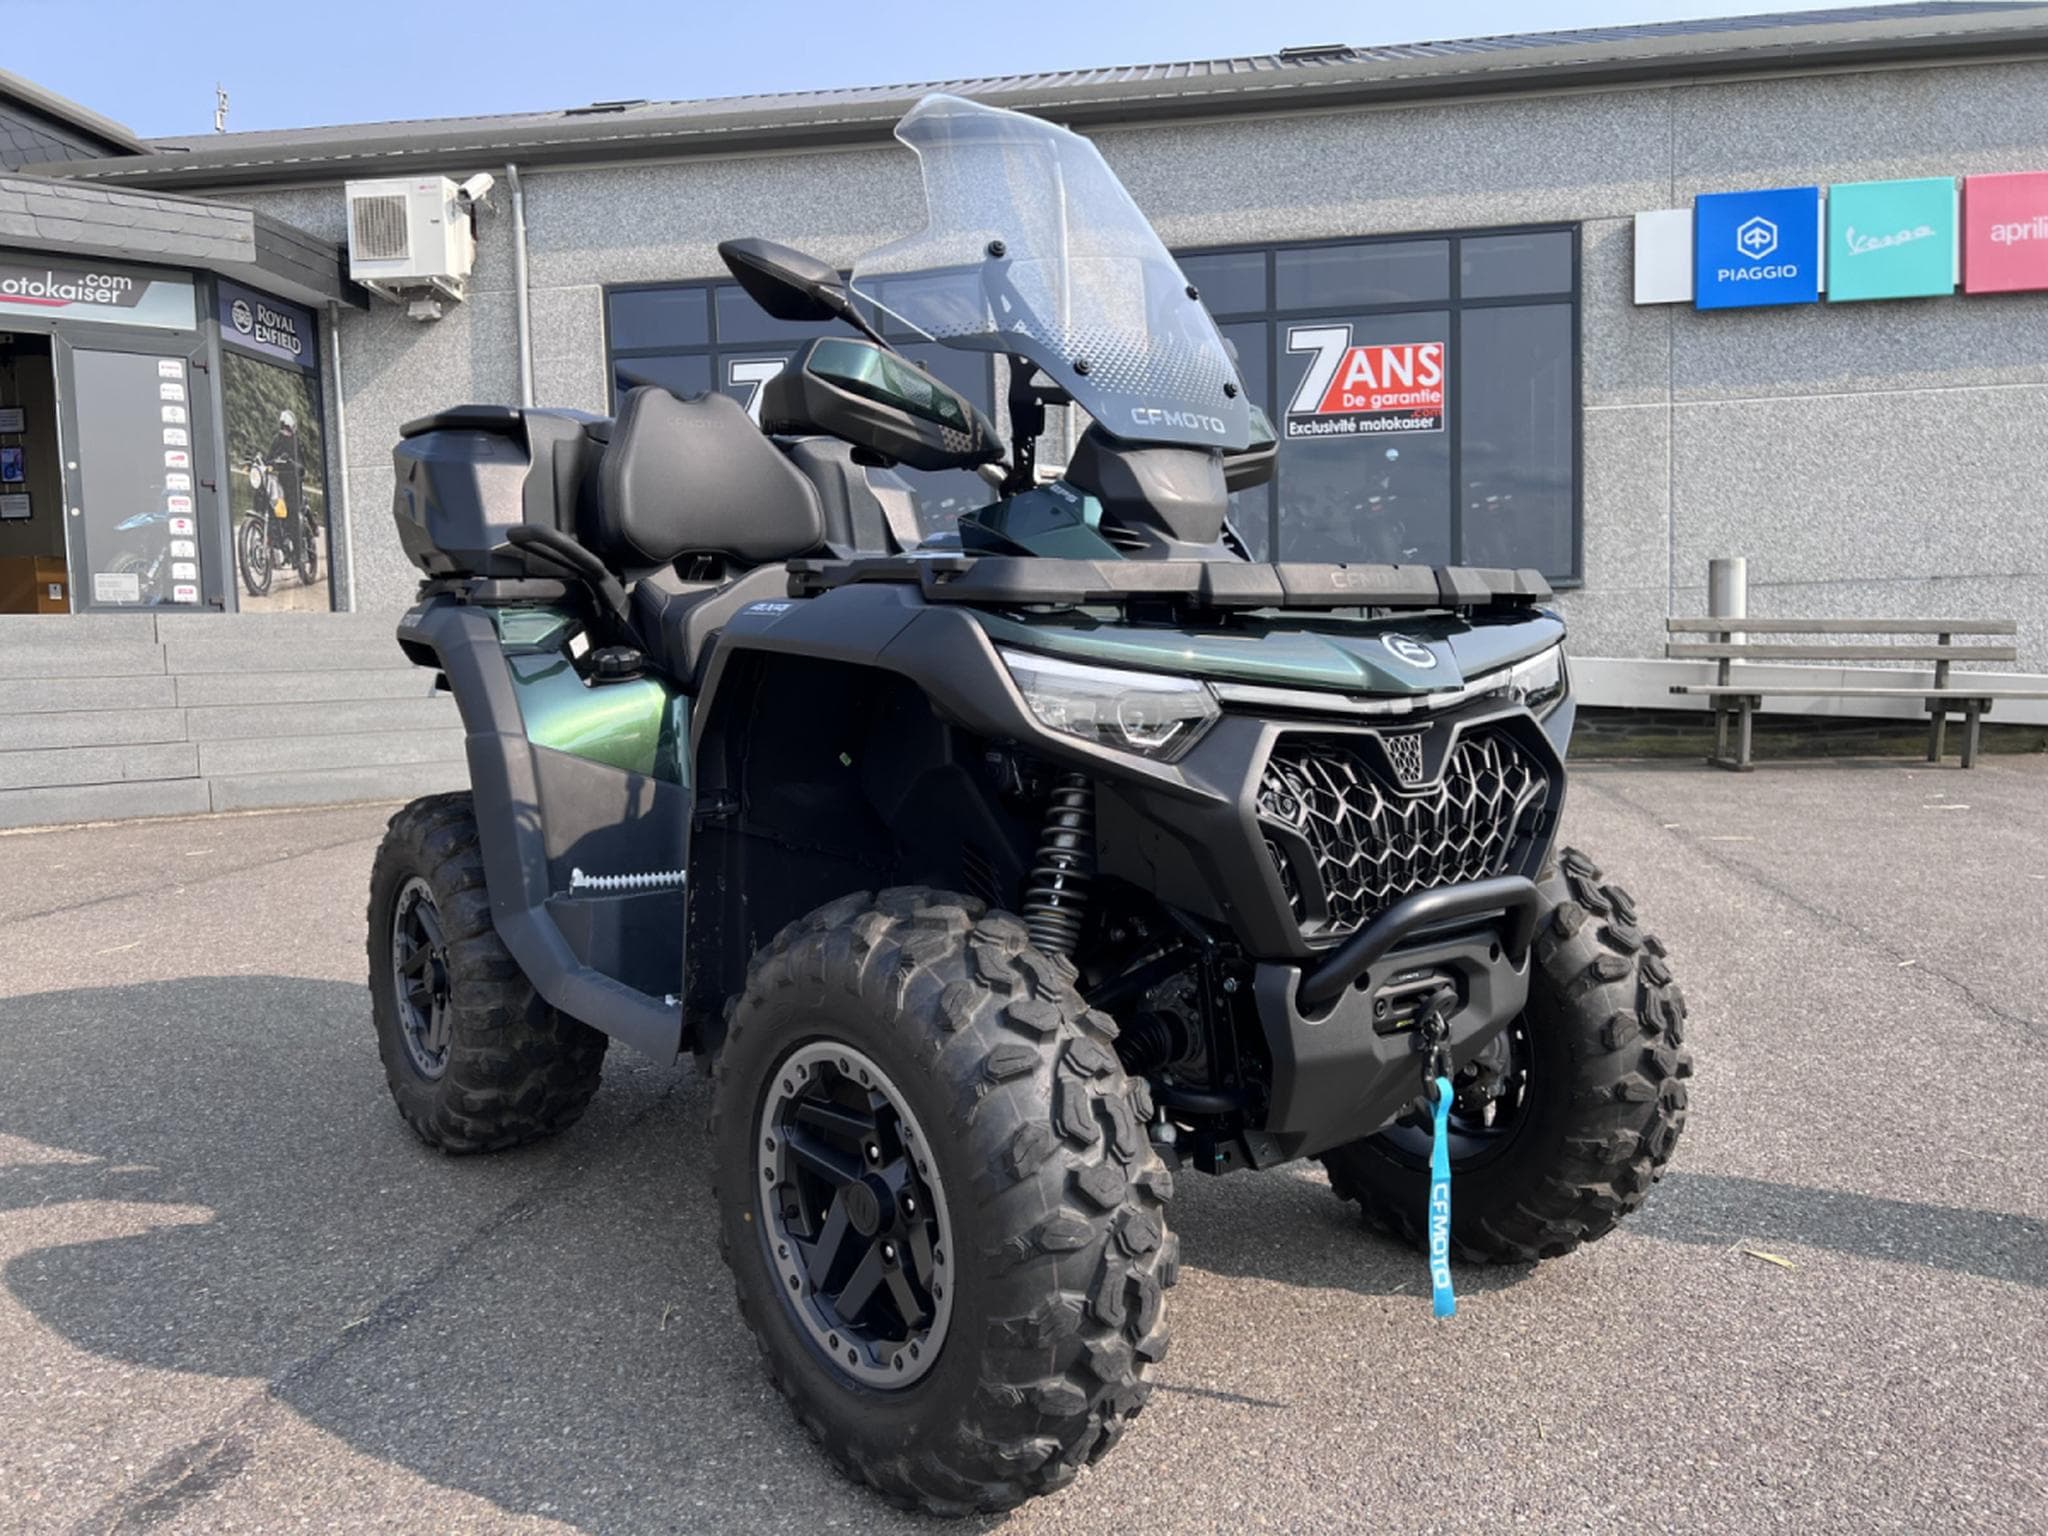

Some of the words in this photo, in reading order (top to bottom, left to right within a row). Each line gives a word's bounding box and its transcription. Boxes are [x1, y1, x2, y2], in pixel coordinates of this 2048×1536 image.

[1846, 225, 1936, 256] Vespa
[1990, 215, 2048, 246] aprili
[0, 271, 121, 303] otokaiser
[1717, 264, 1798, 282] PIAGGIO
[257, 303, 296, 333] ROYAL
[255, 324, 302, 355] ENFIELD
[1290, 327, 1350, 413] 7
[1342, 346, 1441, 390] ANS
[1343, 394, 1365, 407] De
[1371, 390, 1441, 409] garantie
[1131, 408, 1226, 434] CFMOTO
[1289, 419, 1357, 436] Exclusivité
[1359, 416, 1434, 432] motokaiser
[1432, 1183, 1450, 1289] CFMOTO
